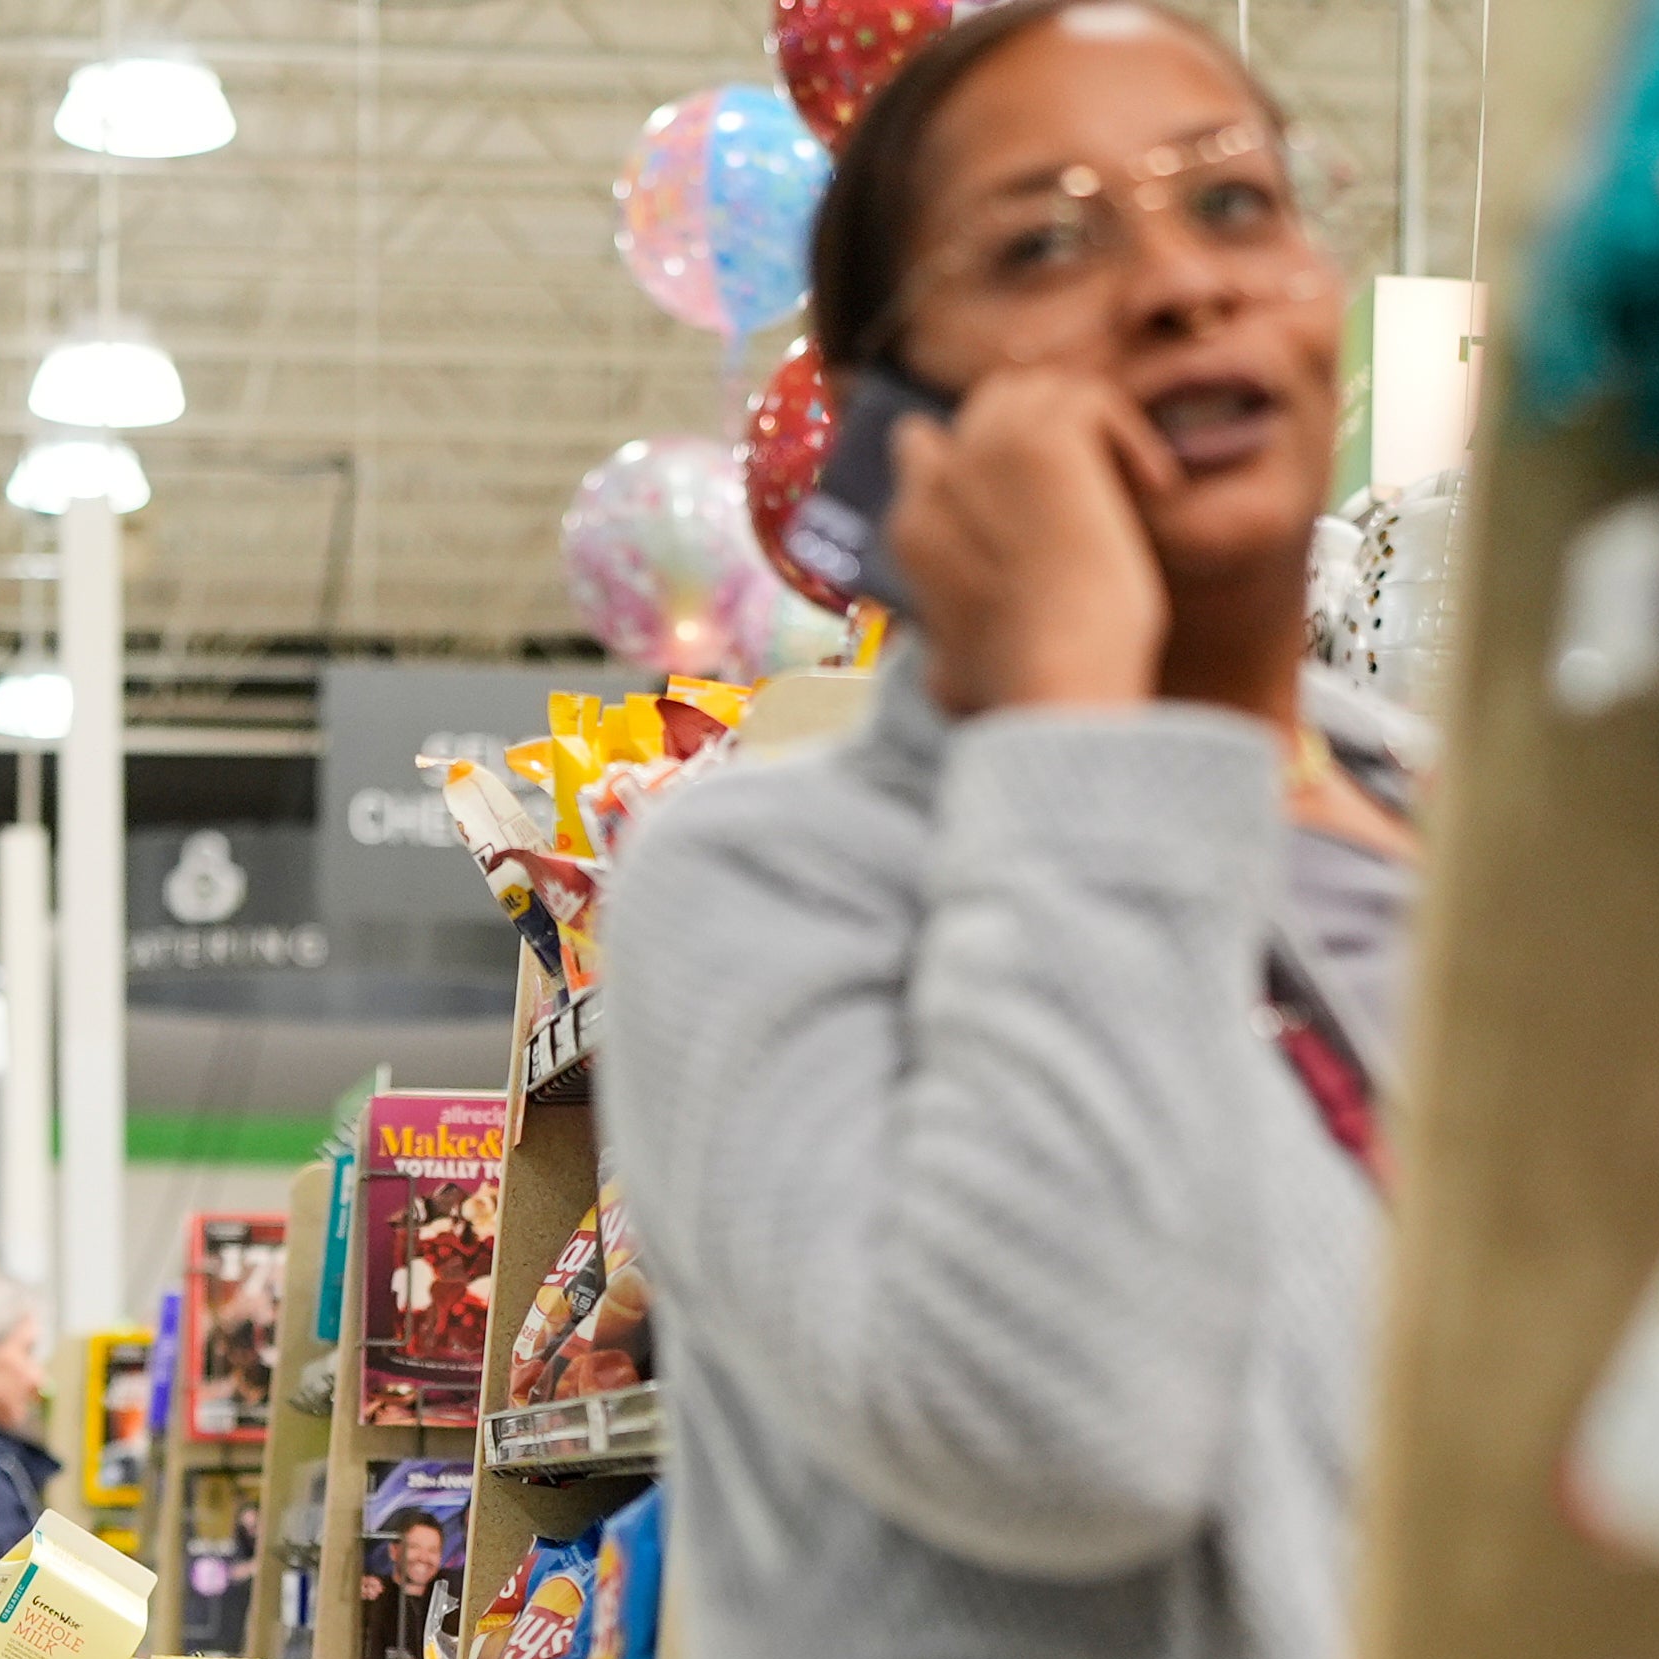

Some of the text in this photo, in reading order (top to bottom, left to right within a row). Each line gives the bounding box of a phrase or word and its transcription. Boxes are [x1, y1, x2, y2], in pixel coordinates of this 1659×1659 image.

[394, 1158, 480, 1179] TOTALLY
[1, 1583, 26, 1620] ORGANIC
[32, 1595, 83, 1630] GreenWise
[13, 1621, 58, 1656] MILK
[24, 1606, 85, 1653] WHOLE
